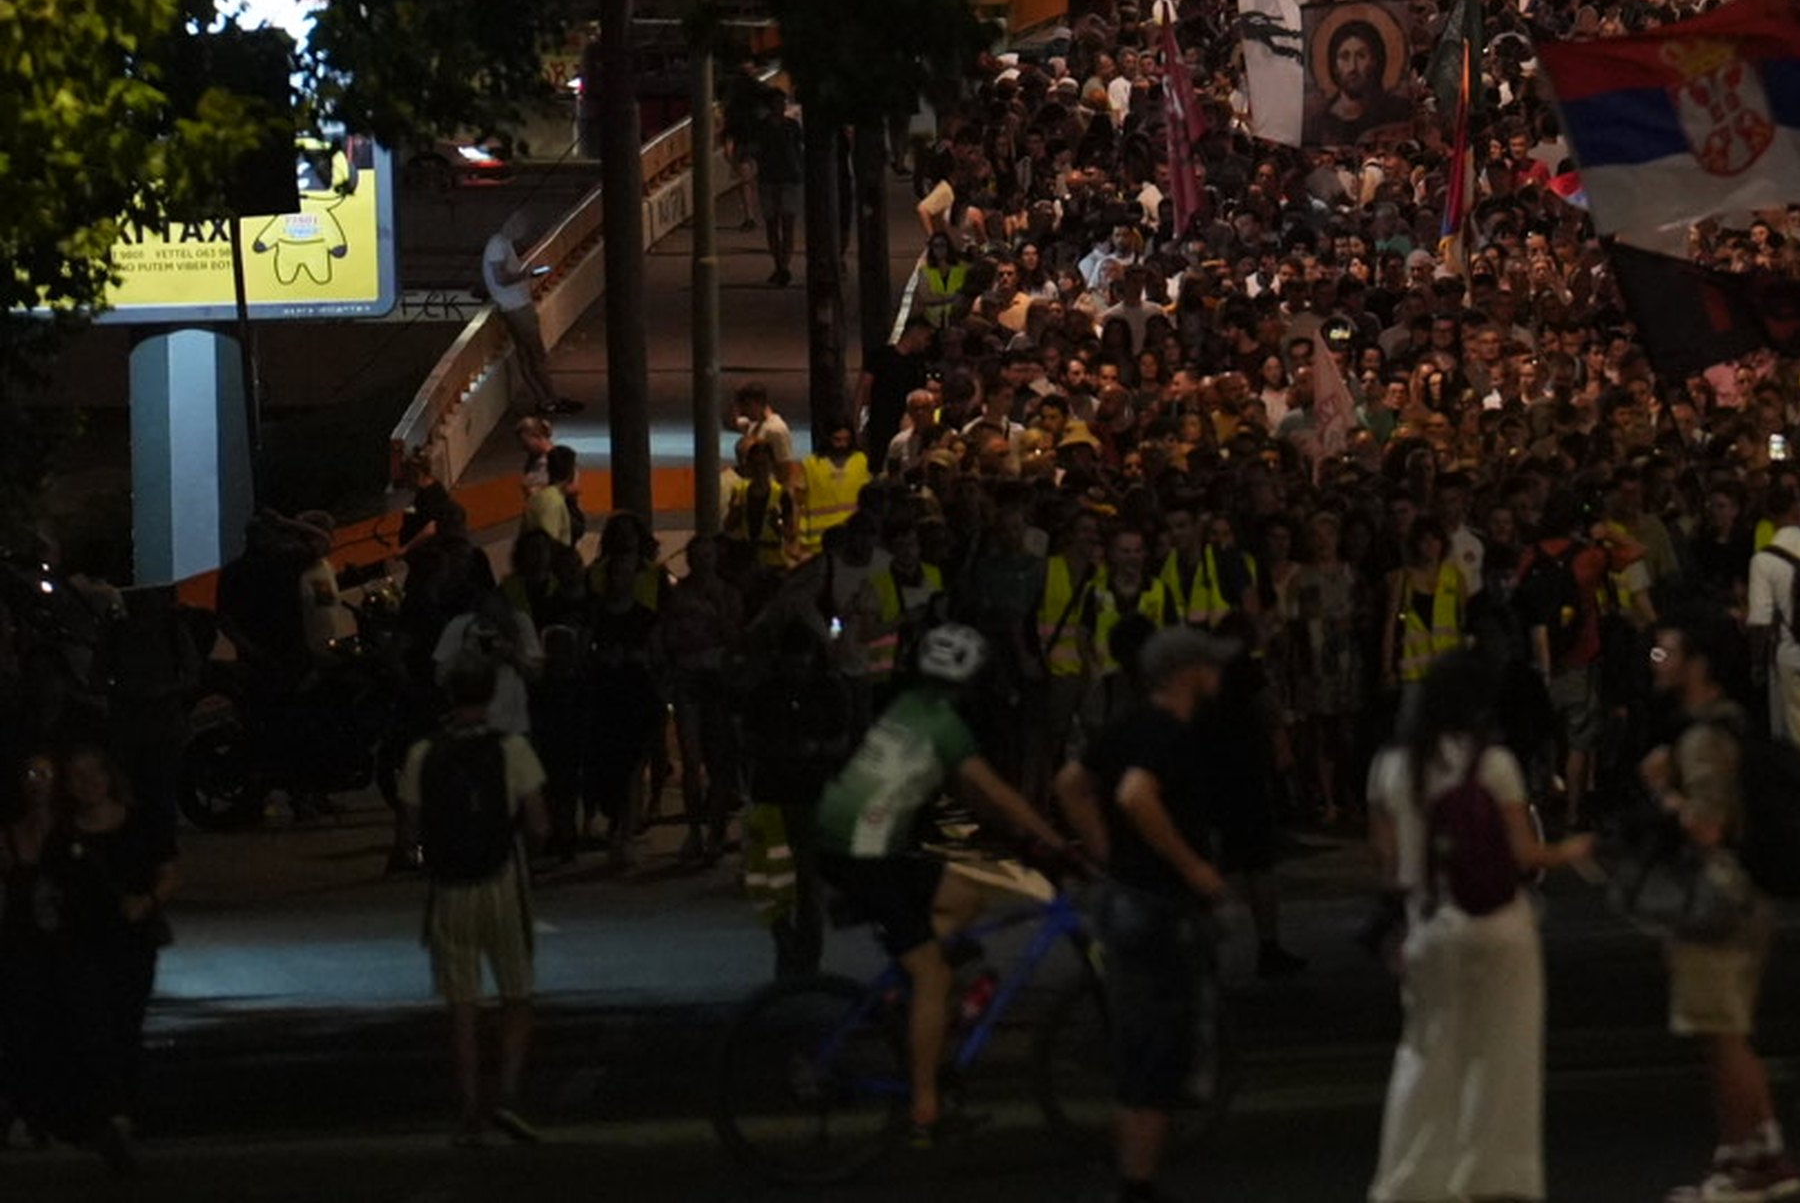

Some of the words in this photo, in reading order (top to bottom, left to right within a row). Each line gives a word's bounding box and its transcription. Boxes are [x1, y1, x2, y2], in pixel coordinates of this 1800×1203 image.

[158, 213, 231, 244] TAX
[137, 262, 173, 273] PUTEM
[209, 260, 231, 271] BOT
